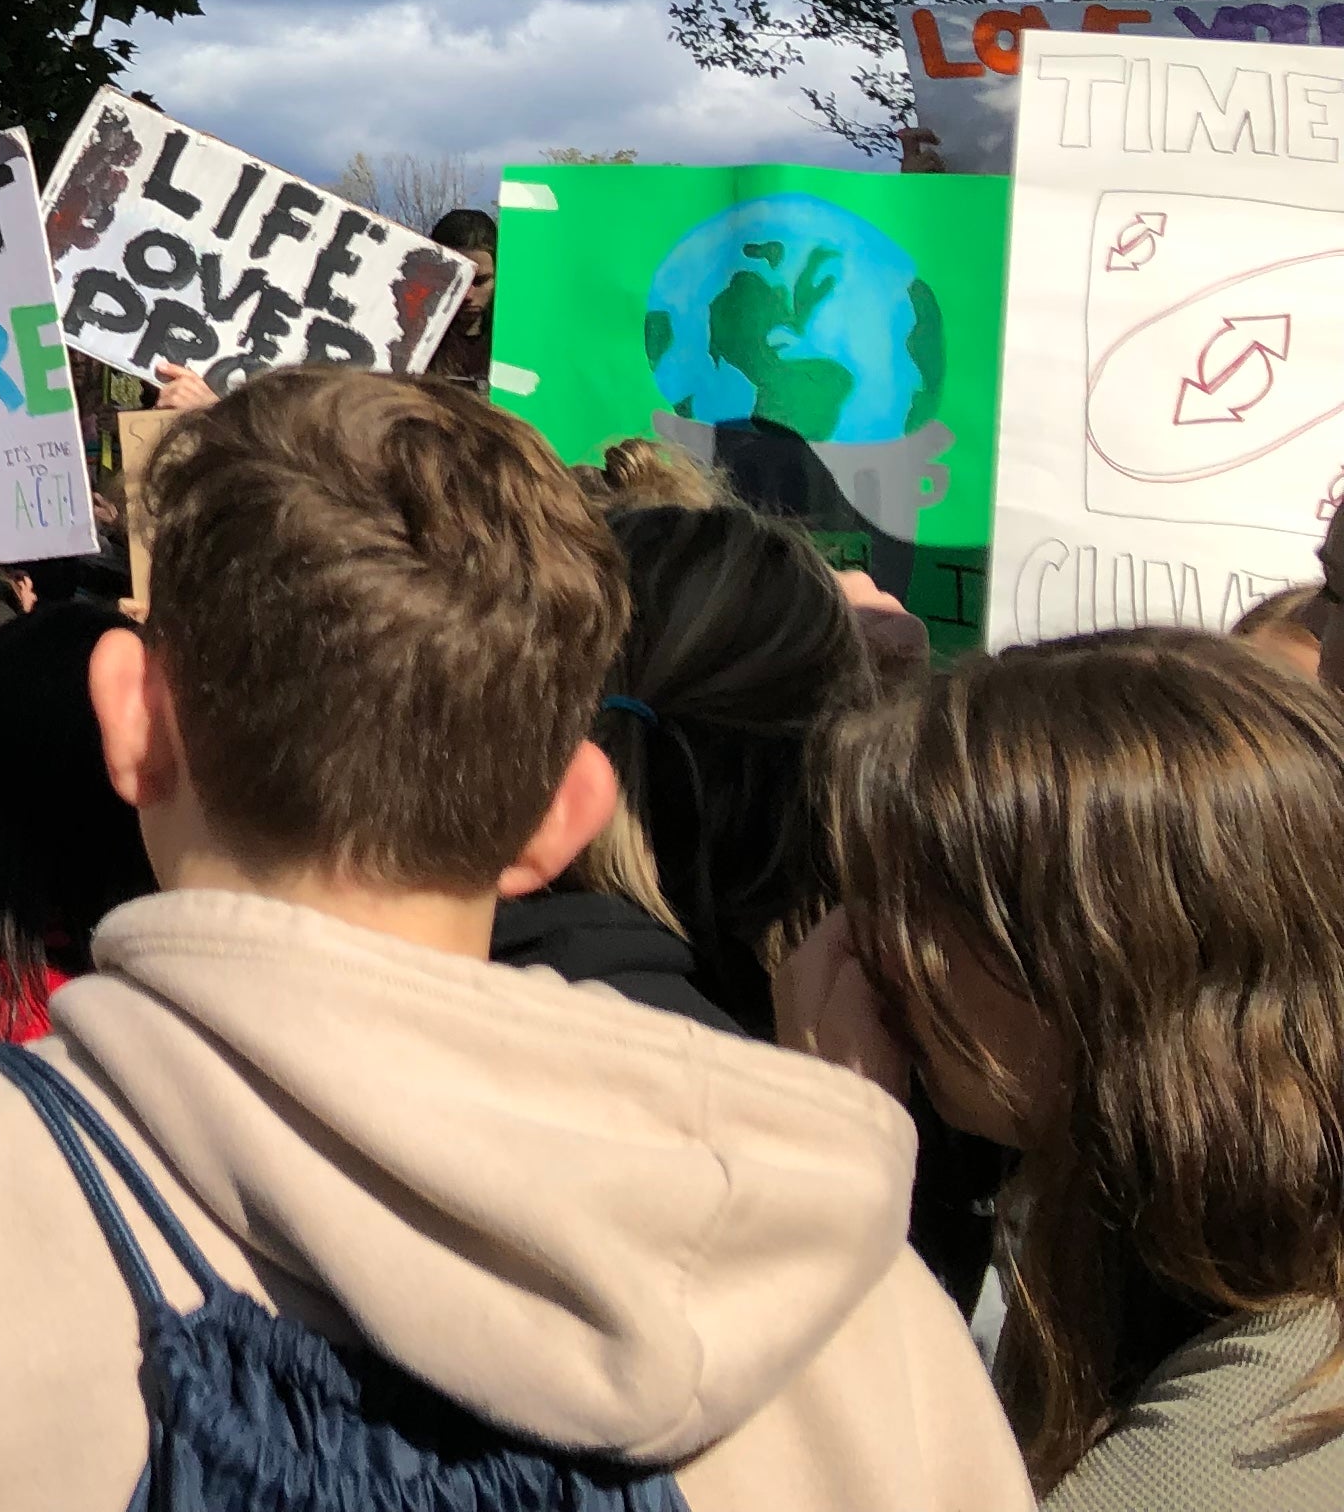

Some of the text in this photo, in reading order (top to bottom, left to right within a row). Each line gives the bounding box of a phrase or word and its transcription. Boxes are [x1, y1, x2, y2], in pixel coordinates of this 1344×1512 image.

[1037, 54, 1344, 163] TIME
[142, 130, 388, 321] LIFE
[26, 464, 48, 477] TO
[37, 441, 71, 459] TIME
